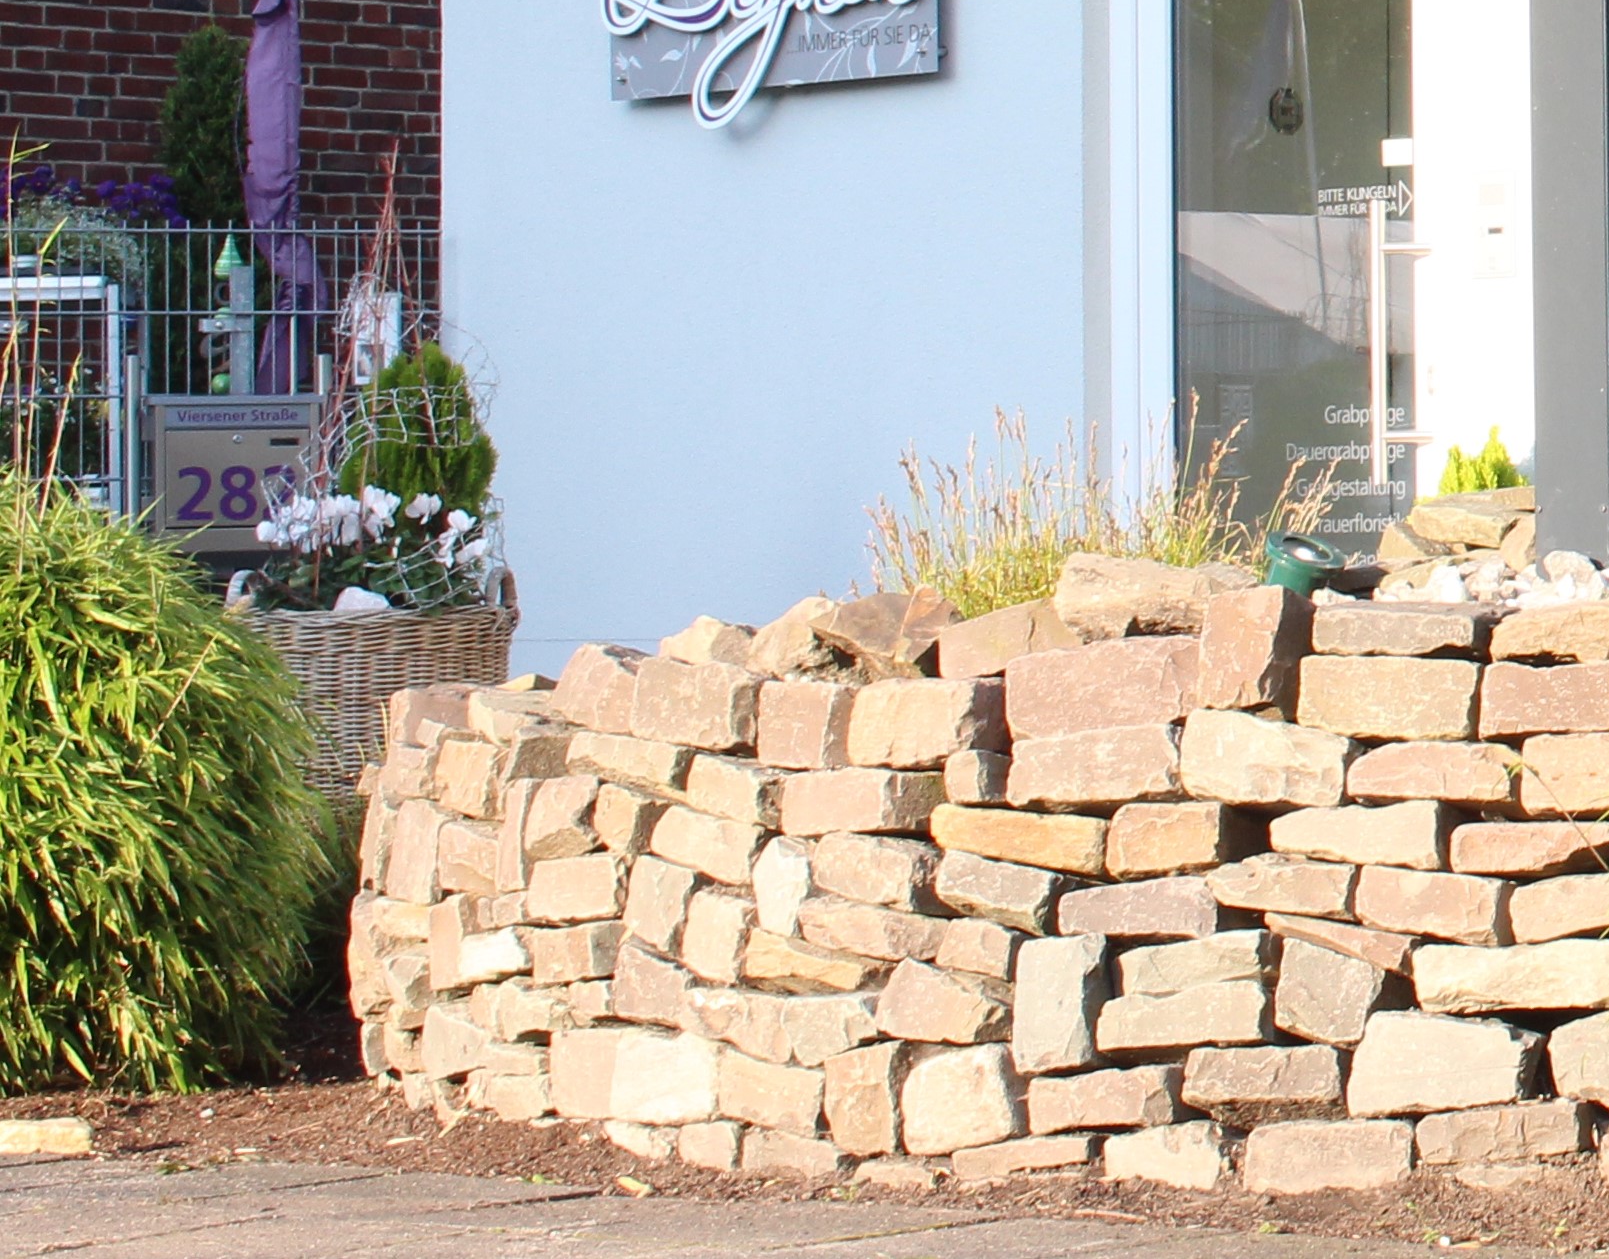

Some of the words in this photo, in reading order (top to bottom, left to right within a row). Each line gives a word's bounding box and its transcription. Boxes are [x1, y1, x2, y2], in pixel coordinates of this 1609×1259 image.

[852, 25, 880, 47] FÜR
[884, 25, 904, 46] SIE
[909, 23, 933, 43] DA
[1318, 188, 1345, 203] BITTE
[1346, 185, 1397, 201] KLINGELN
[177, 409, 247, 423] Viersener
[251, 408, 298, 422] Straße
[1324, 404, 1405, 428] Grabpge
[1286, 440, 1406, 464] Dauergrabpge
